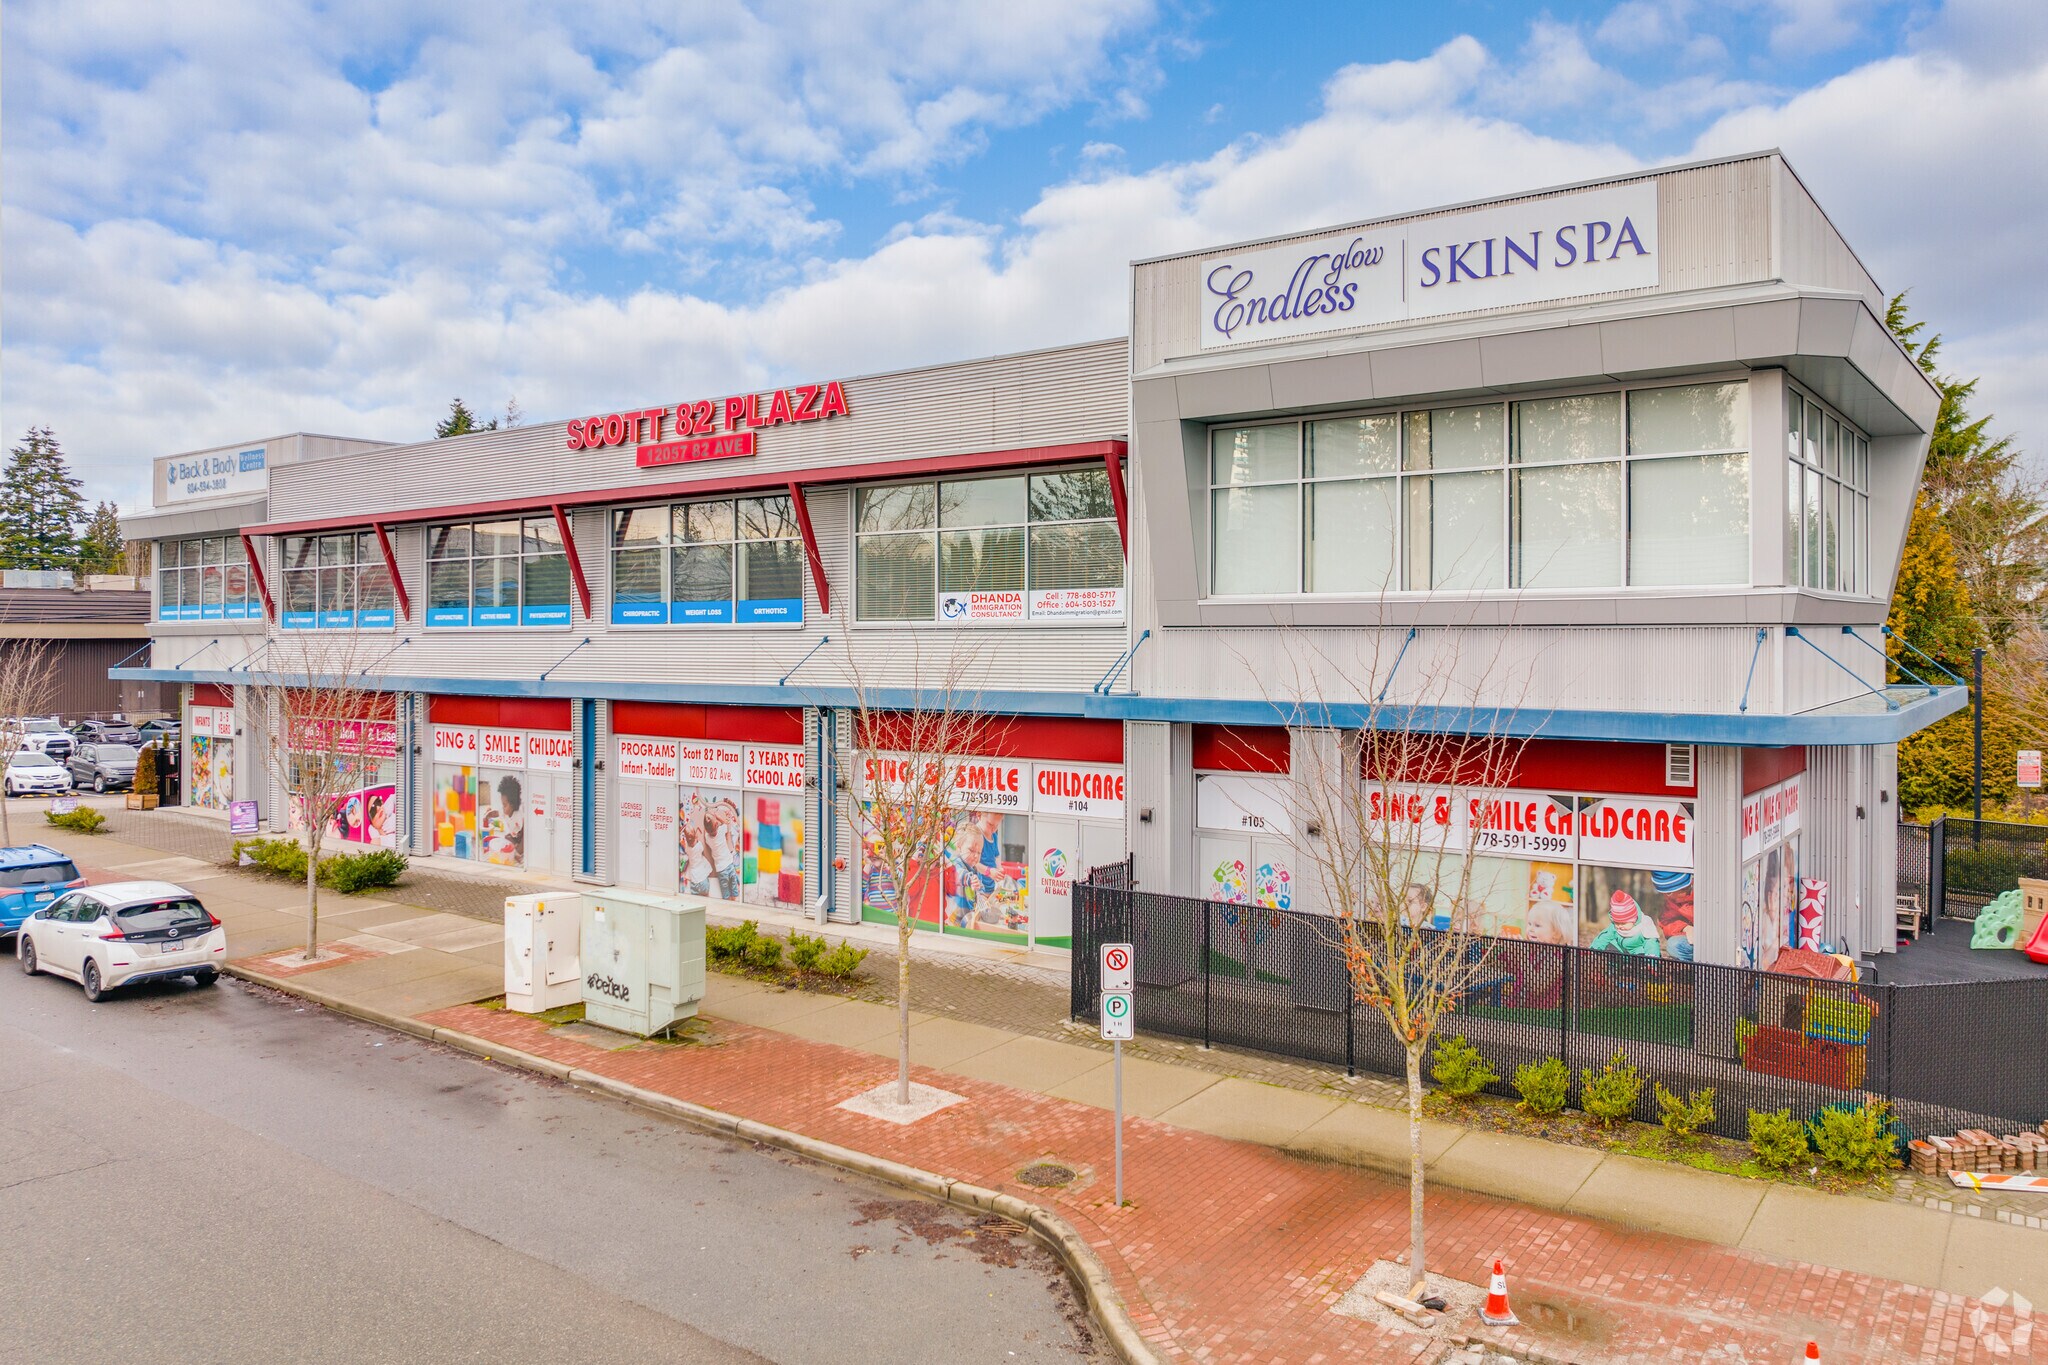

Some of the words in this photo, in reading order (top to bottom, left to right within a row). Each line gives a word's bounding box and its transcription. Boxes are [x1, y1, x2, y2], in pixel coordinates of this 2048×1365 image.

[1419, 230, 1544, 288] SKIN
[1554, 216, 1651, 268] SPA
[1324, 237, 1384, 285] glow
[1206, 253, 1358, 340] Endless
[566, 407, 667, 450] SCOTT
[675, 400, 715, 436] 82
[724, 381, 849, 431] PLAZA
[648, 445, 687, 463] 12057
[692, 442, 709, 457] 82
[714, 438, 743, 455] AVE
[179, 461, 201, 480] Back
[203, 459, 210, 476] &
[212, 455, 236, 477] Body
[971, 593, 1021, 603] DHANDA
[1045, 592, 1059, 600] Cell
[1066, 591, 1116, 599] 778-680-5717
[1037, 601, 1059, 609] Office
[1065, 600, 1116, 608] 604-503-1527
[376, 729, 396, 742] Lase
[435, 731, 464, 748] SING
[468, 734, 476, 750] &
[485, 735, 520, 753] SMILE
[529, 737, 572, 757] CHILDCAR
[621, 742, 675, 758] PROGRAMS
[482, 754, 523, 765] 778-591-5999
[683, 747, 701, 760] Scott
[703, 748, 714, 761] 82
[716, 749, 739, 763] Plaza
[749, 750, 755, 765] 3
[758, 751, 790, 767] YEARS
[792, 753, 804, 768] TO
[689, 766, 707, 779] 12057
[709, 767, 718, 779] 82
[719, 768, 733, 781] Ave.
[747, 769, 784, 786] SCHOOL
[787, 772, 804, 788] AG
[956, 765, 1018, 792] SMILE
[1037, 770, 1123, 801] CHILDCARE
[960, 791, 1018, 806] 778-591-5999
[1069, 800, 1088, 812] #104
[556, 803, 572, 811] TODDLE
[1370, 791, 1424, 824] SING
[1434, 796, 1452, 826] &
[1469, 798, 1537, 833] SMILE
[555, 811, 572, 819] PROGRA
[1241, 815, 1265, 828] #105
[1041, 878, 1070, 888] ENTRANCE
[1045, 886, 1051, 894] AT
[1052, 887, 1068, 896] BACK
[1112, 1001, 1121, 1012] P
